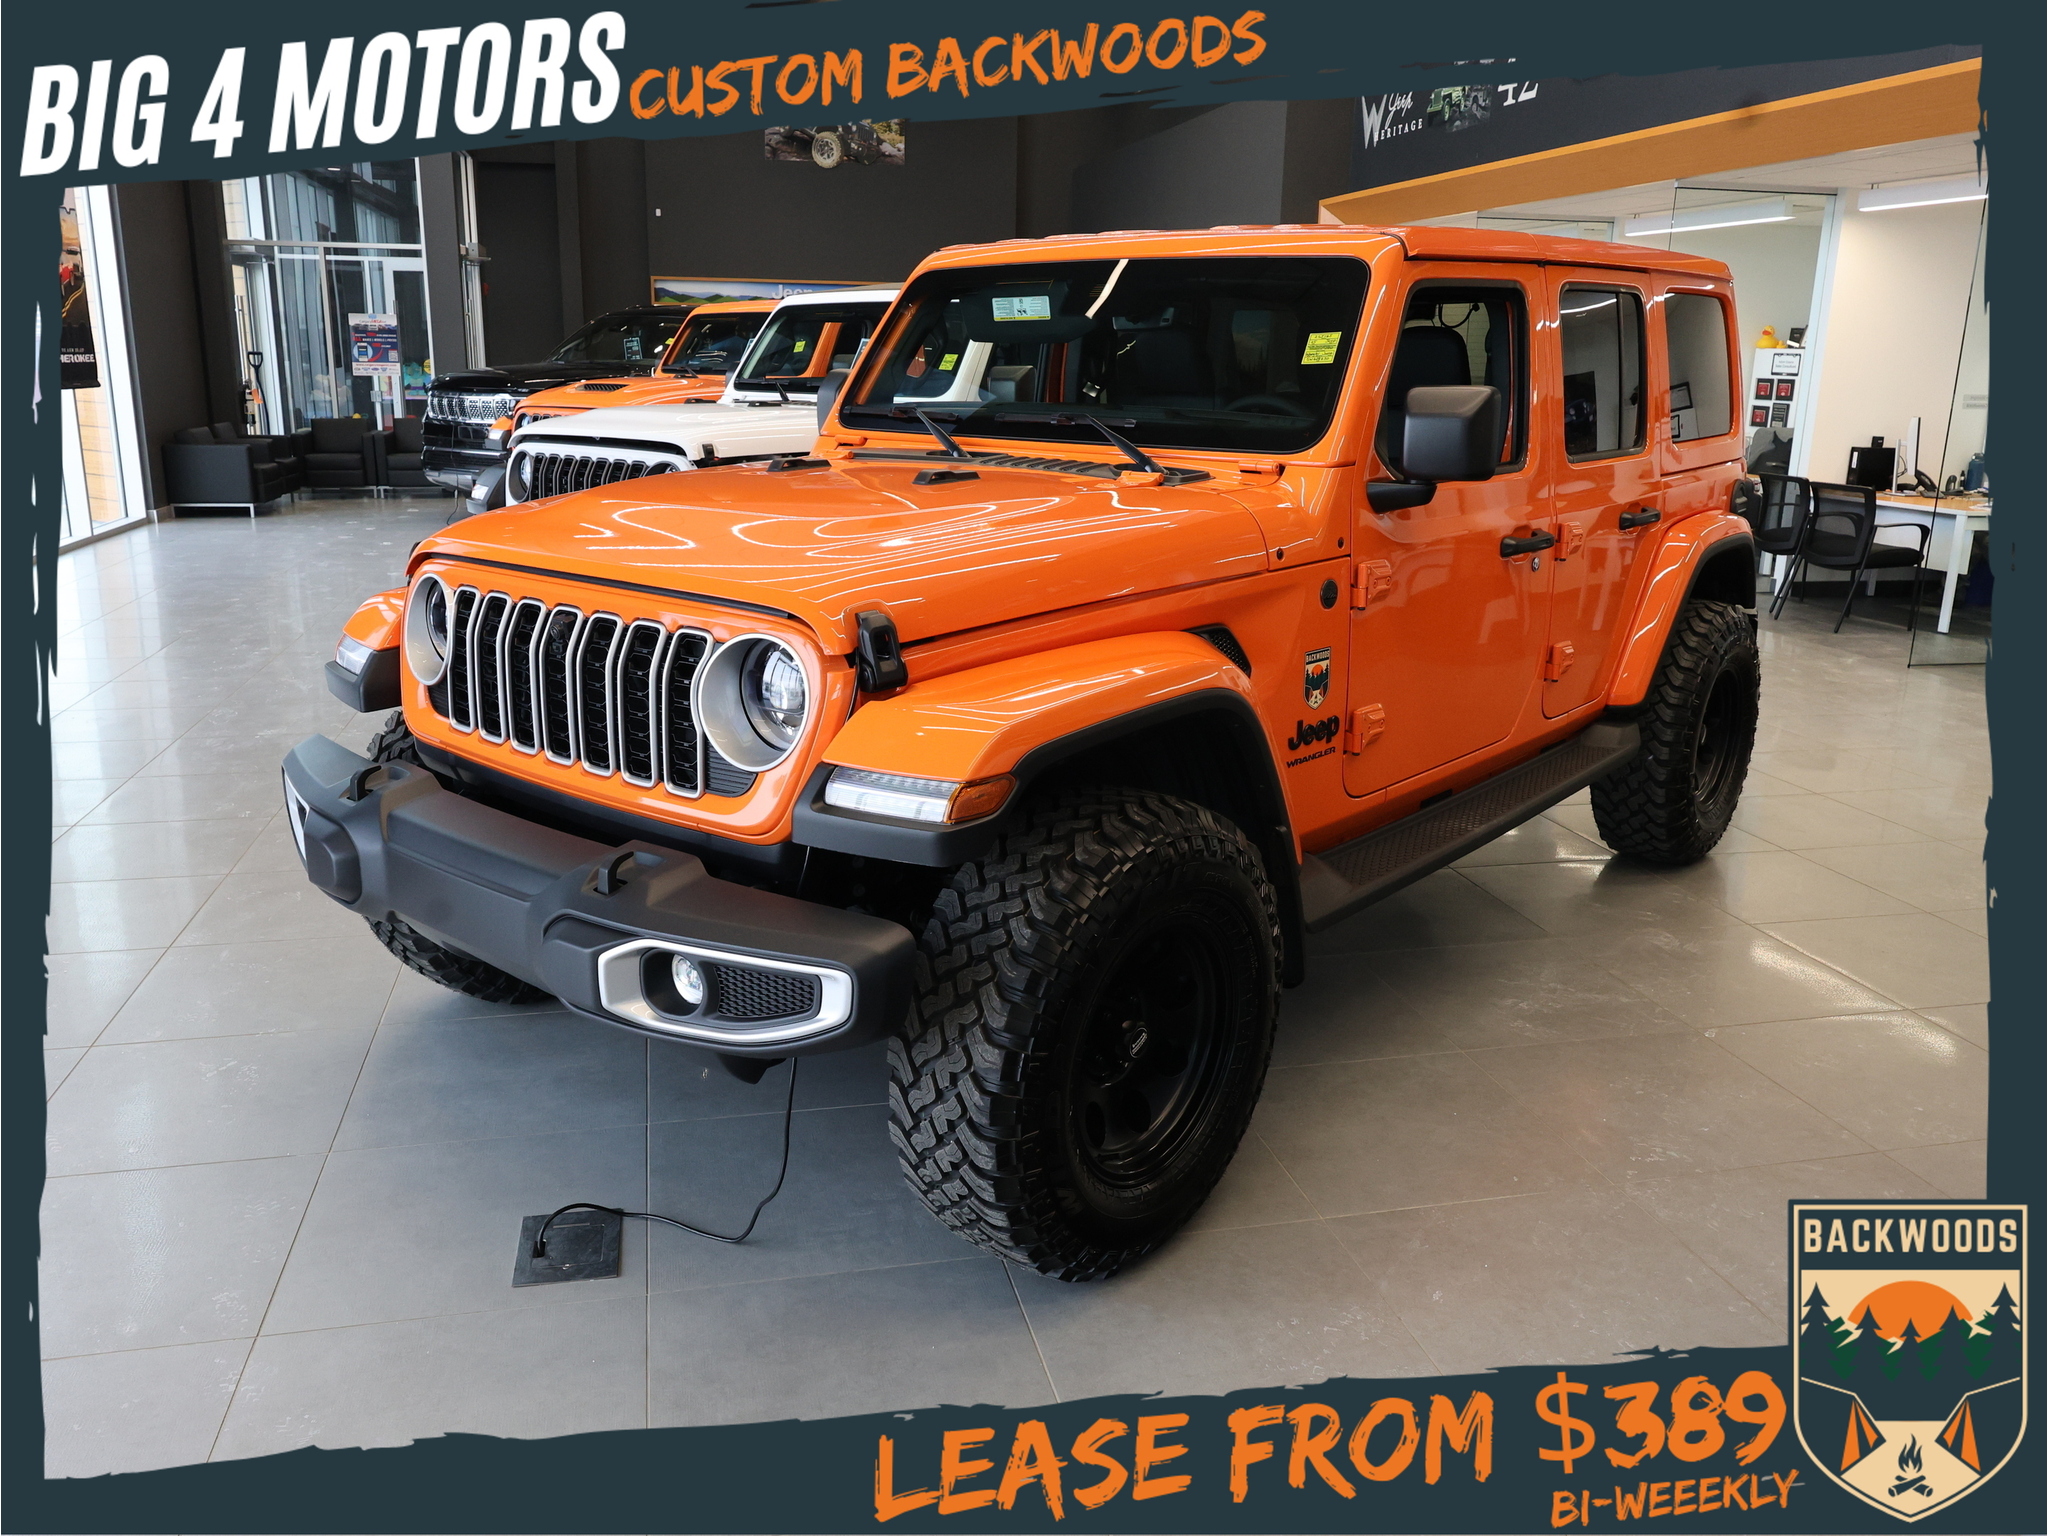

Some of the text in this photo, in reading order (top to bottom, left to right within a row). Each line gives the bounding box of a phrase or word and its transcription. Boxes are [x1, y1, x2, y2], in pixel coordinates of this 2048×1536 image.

[1373, 118, 1423, 142] HERITAGE
[771, 284, 814, 300] Jee
[1305, 650, 1330, 663] BACKWOODS
[1288, 715, 1340, 750] Jeep
[1286, 746, 1336, 768] WRANGLER
